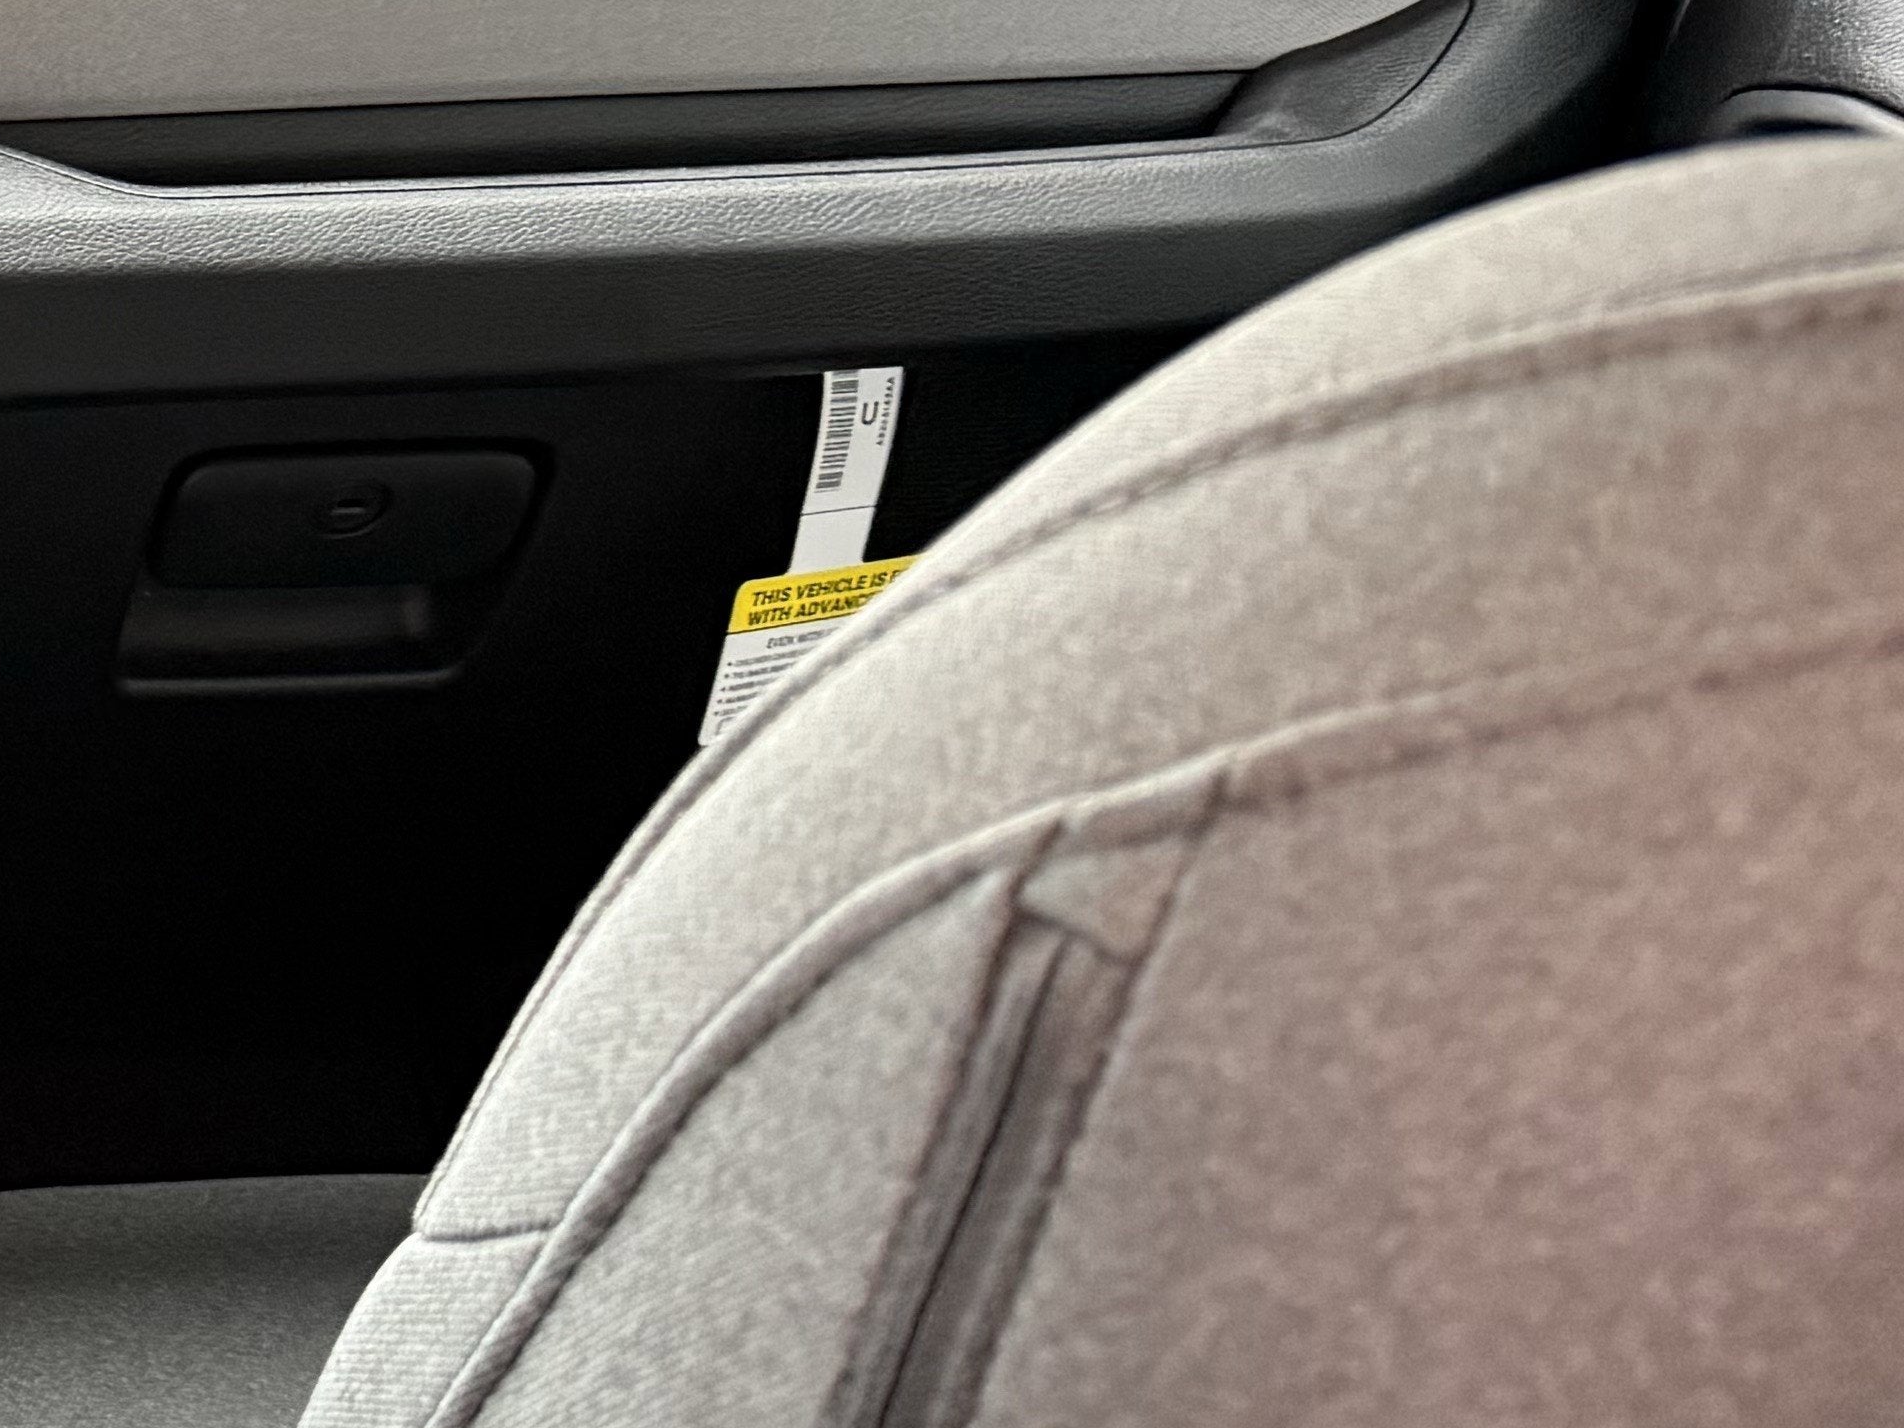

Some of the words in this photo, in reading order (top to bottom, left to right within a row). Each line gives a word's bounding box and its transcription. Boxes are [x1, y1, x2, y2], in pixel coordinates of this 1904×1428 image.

[750, 587, 792, 607] THIS
[796, 574, 868, 599] VEHICLE
[869, 571, 889, 588] IS
[747, 605, 793, 626] WITH
